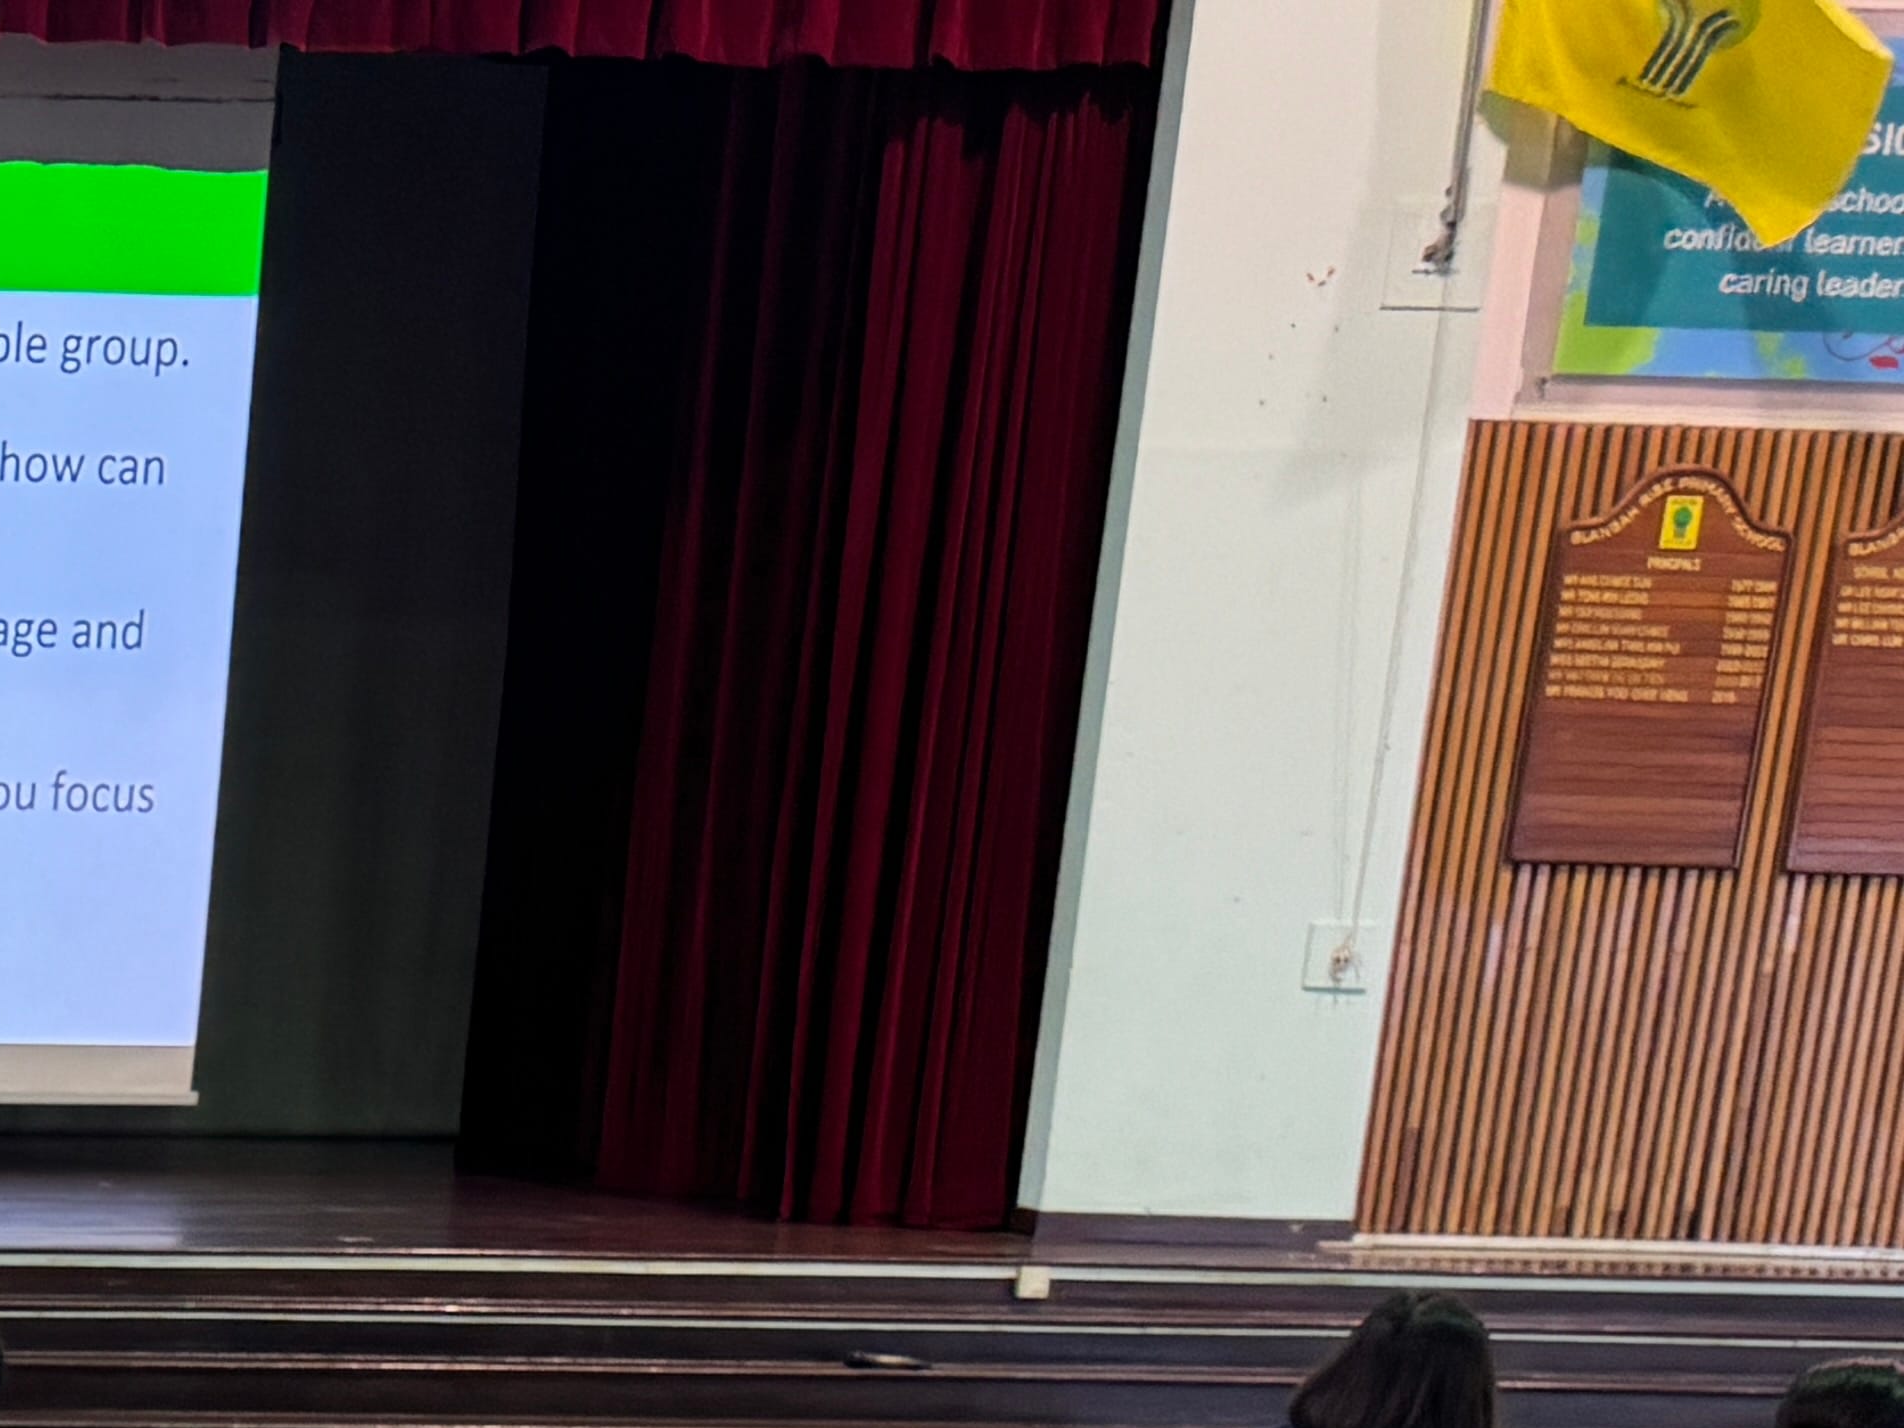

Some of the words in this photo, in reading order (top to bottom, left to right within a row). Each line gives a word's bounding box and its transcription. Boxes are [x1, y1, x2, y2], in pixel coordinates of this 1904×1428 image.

[1804, 226, 1904, 256] learner
[1718, 267, 1809, 302] caring
[1816, 269, 1904, 298] leader
[60, 335, 188, 376] group.
[0, 440, 84, 483] how
[98, 455, 163, 485] can
[72, 609, 144, 650] and
[52, 770, 153, 813] focus
